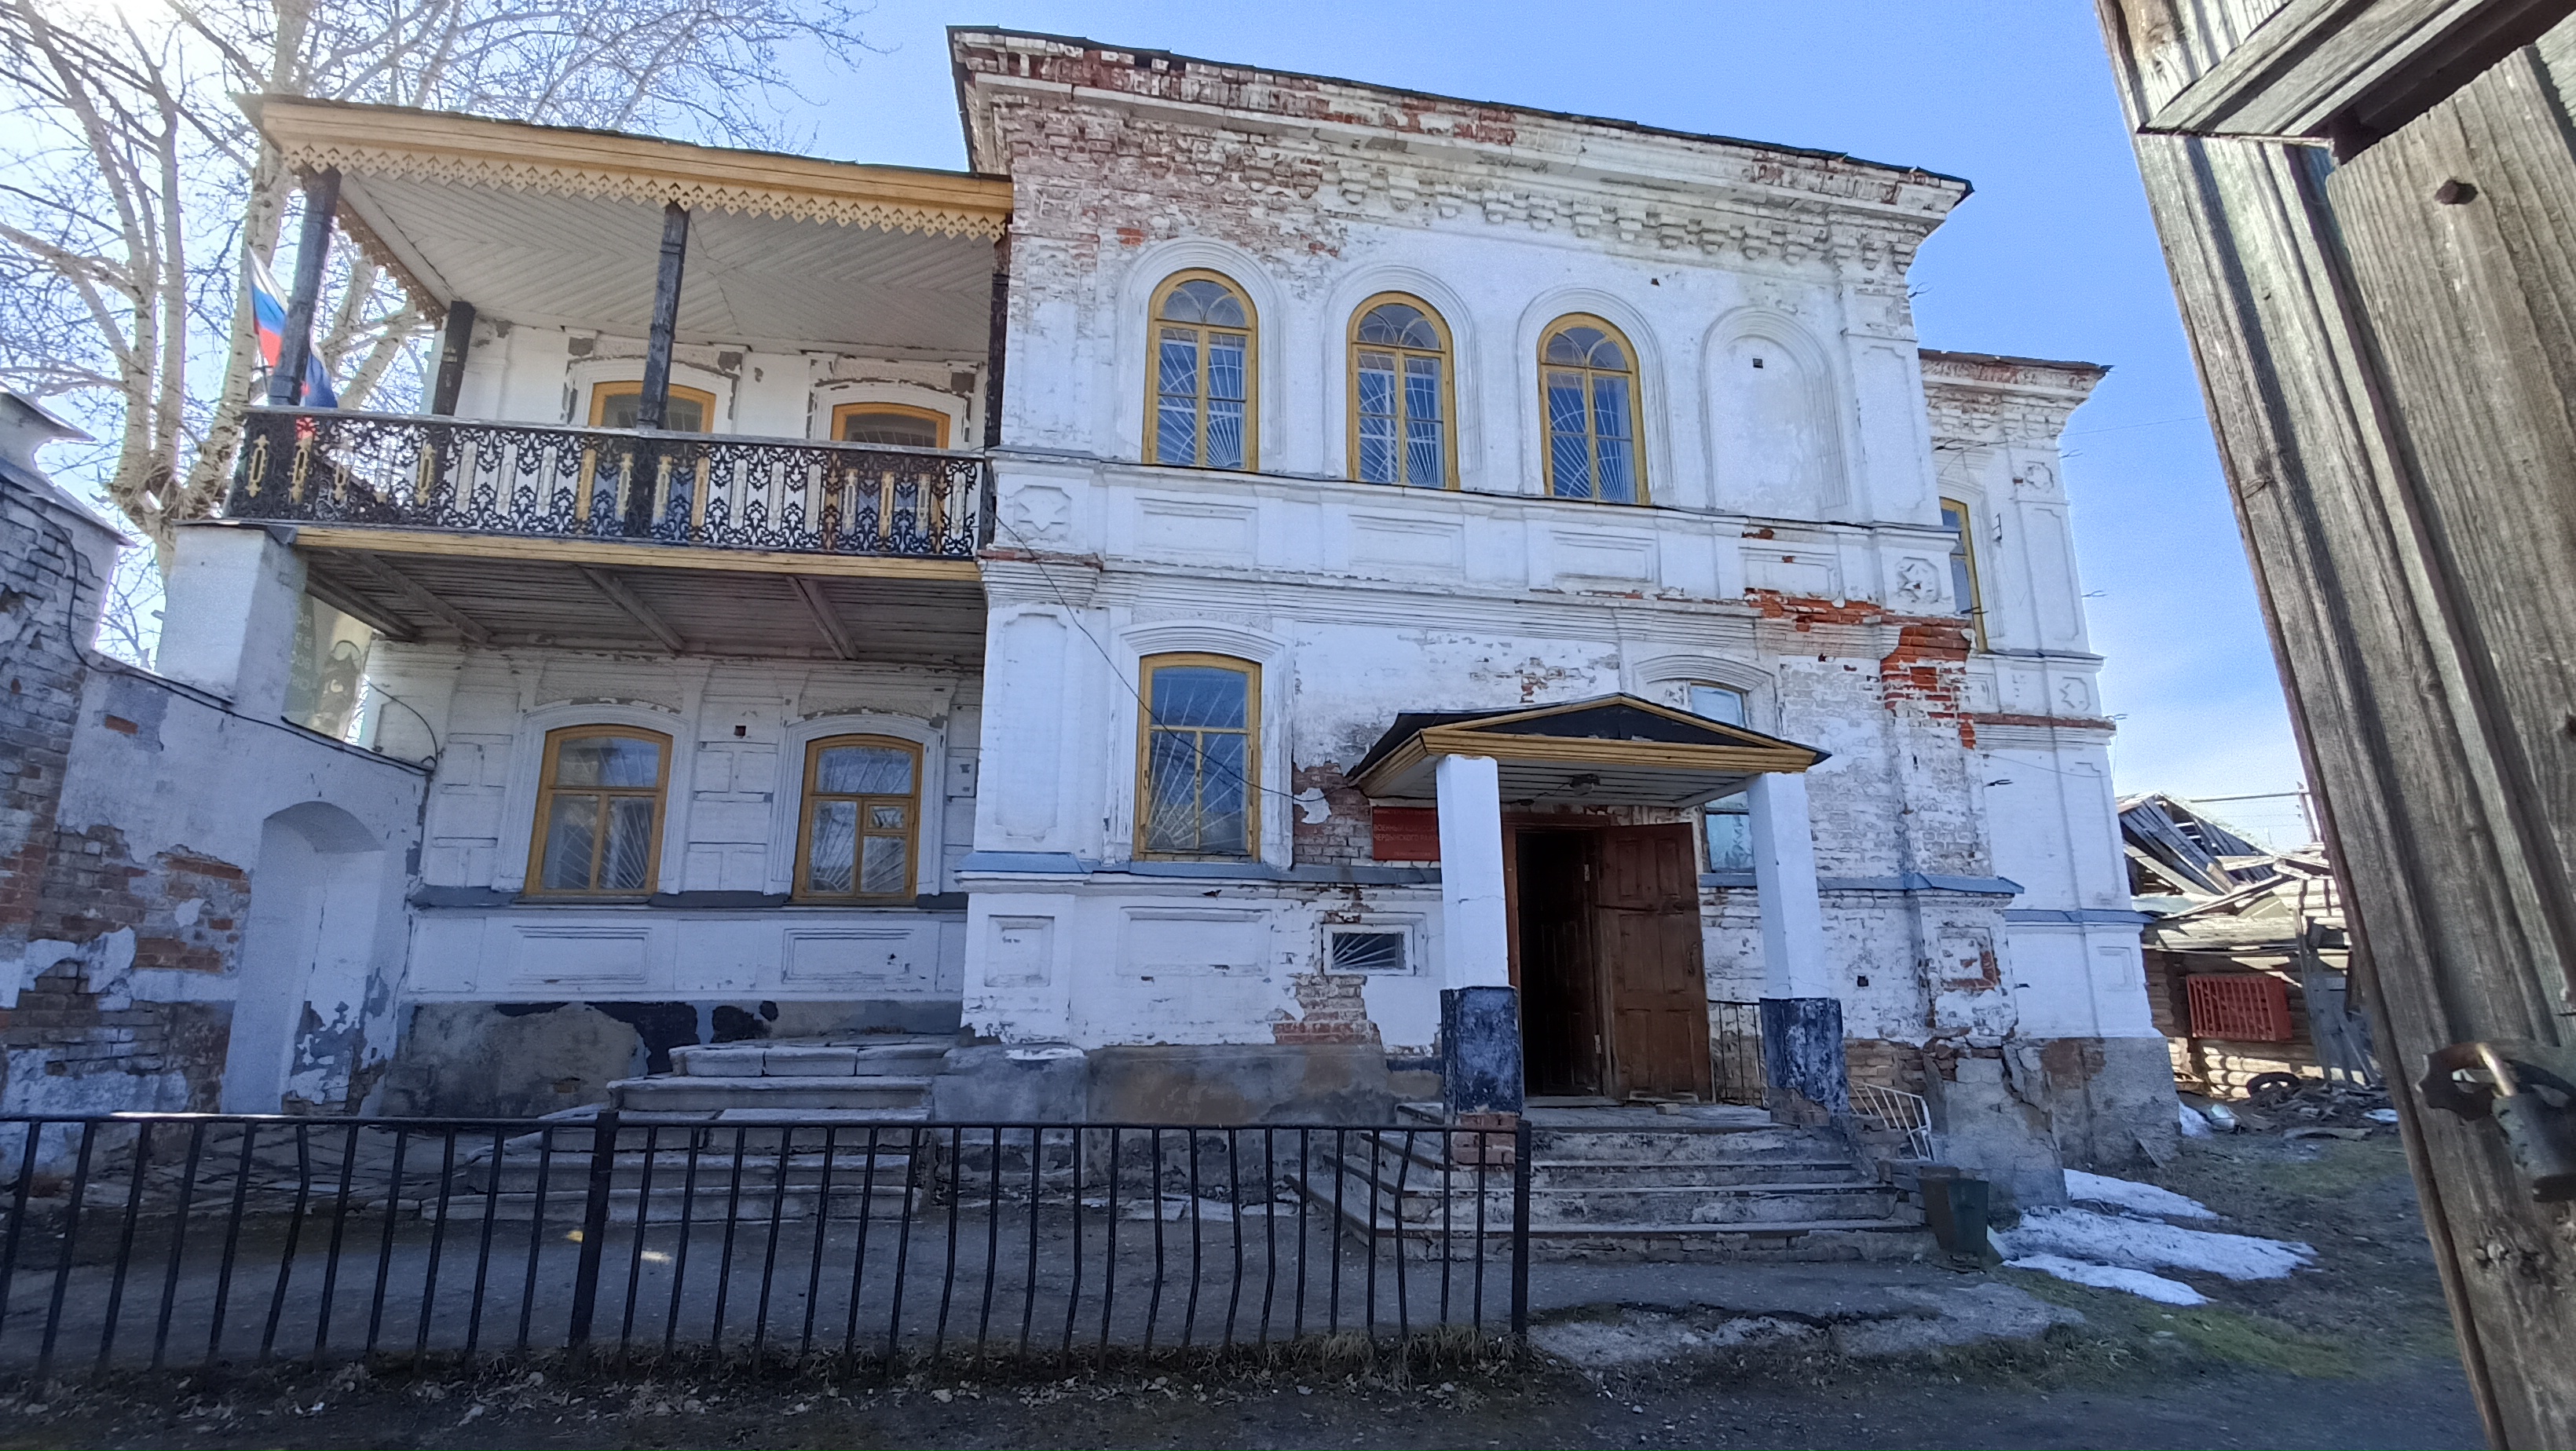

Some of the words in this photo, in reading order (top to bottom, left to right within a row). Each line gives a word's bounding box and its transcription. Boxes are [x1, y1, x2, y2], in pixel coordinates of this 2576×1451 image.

[1373, 824, 1404, 832] ВОЕННЫЙ
[1373, 833, 1419, 842] ЧЕРДЫНСКОГО
[1421, 834, 1439, 842] РАЙО
